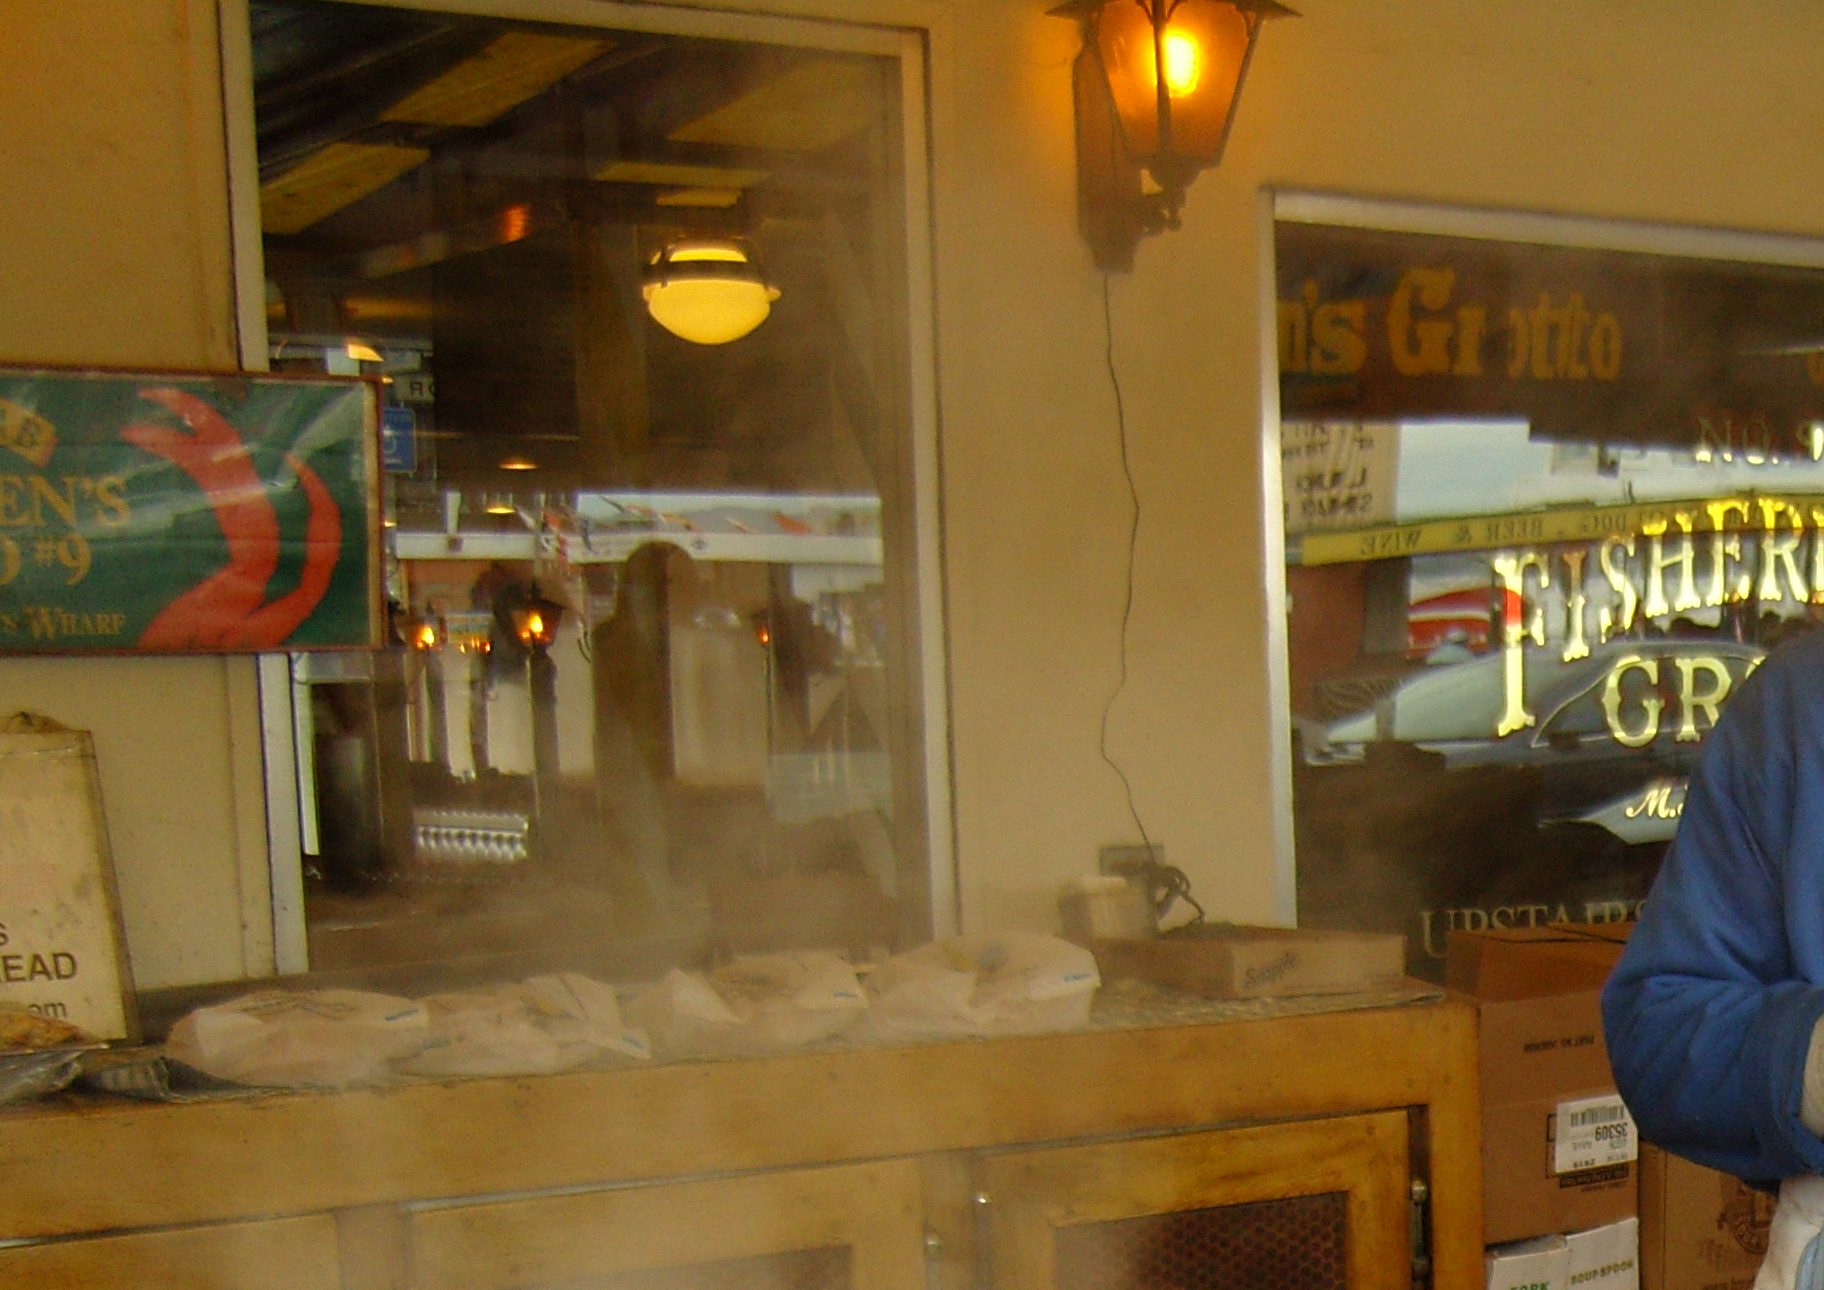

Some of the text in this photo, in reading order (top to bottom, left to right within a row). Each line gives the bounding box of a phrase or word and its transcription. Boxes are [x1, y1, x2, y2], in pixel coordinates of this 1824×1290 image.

[0, 952, 78, 983] EAD
[1594, 1121, 1629, 1142] 35309
[1570, 1259, 1634, 1286] SOUP SPOON
